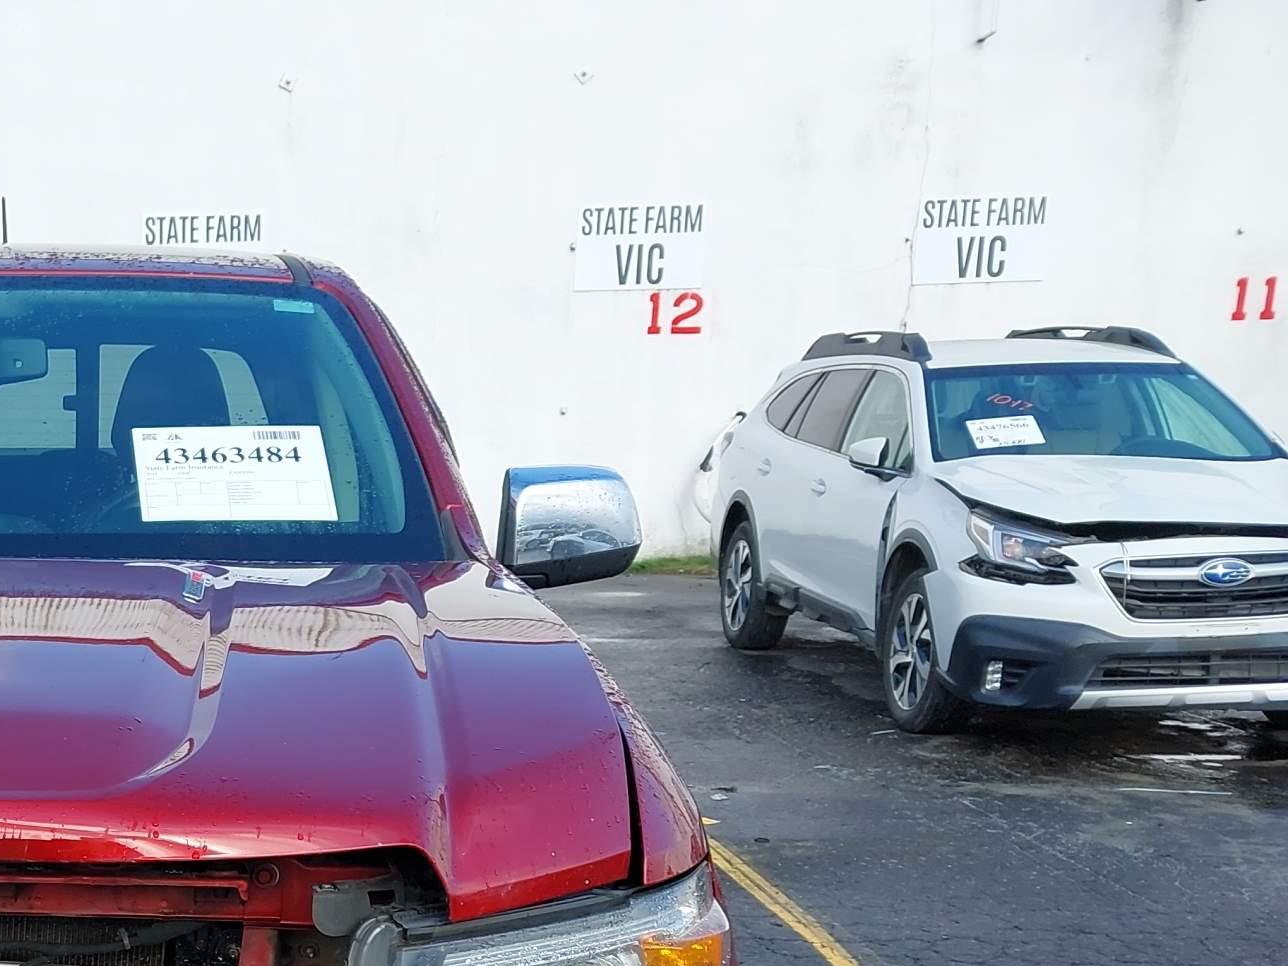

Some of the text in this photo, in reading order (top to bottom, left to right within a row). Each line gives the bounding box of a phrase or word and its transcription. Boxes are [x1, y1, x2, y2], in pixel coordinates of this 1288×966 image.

[145, 214, 261, 246] STATE FARM
[582, 204, 704, 236] STATE FARM
[923, 196, 1048, 229] STATE FARM
[615, 243, 665, 285] VIC
[956, 235, 1007, 279] VIC
[647, 292, 704, 334] 12
[1231, 276, 1279, 321] 11
[155, 445, 303, 464] 43463484
